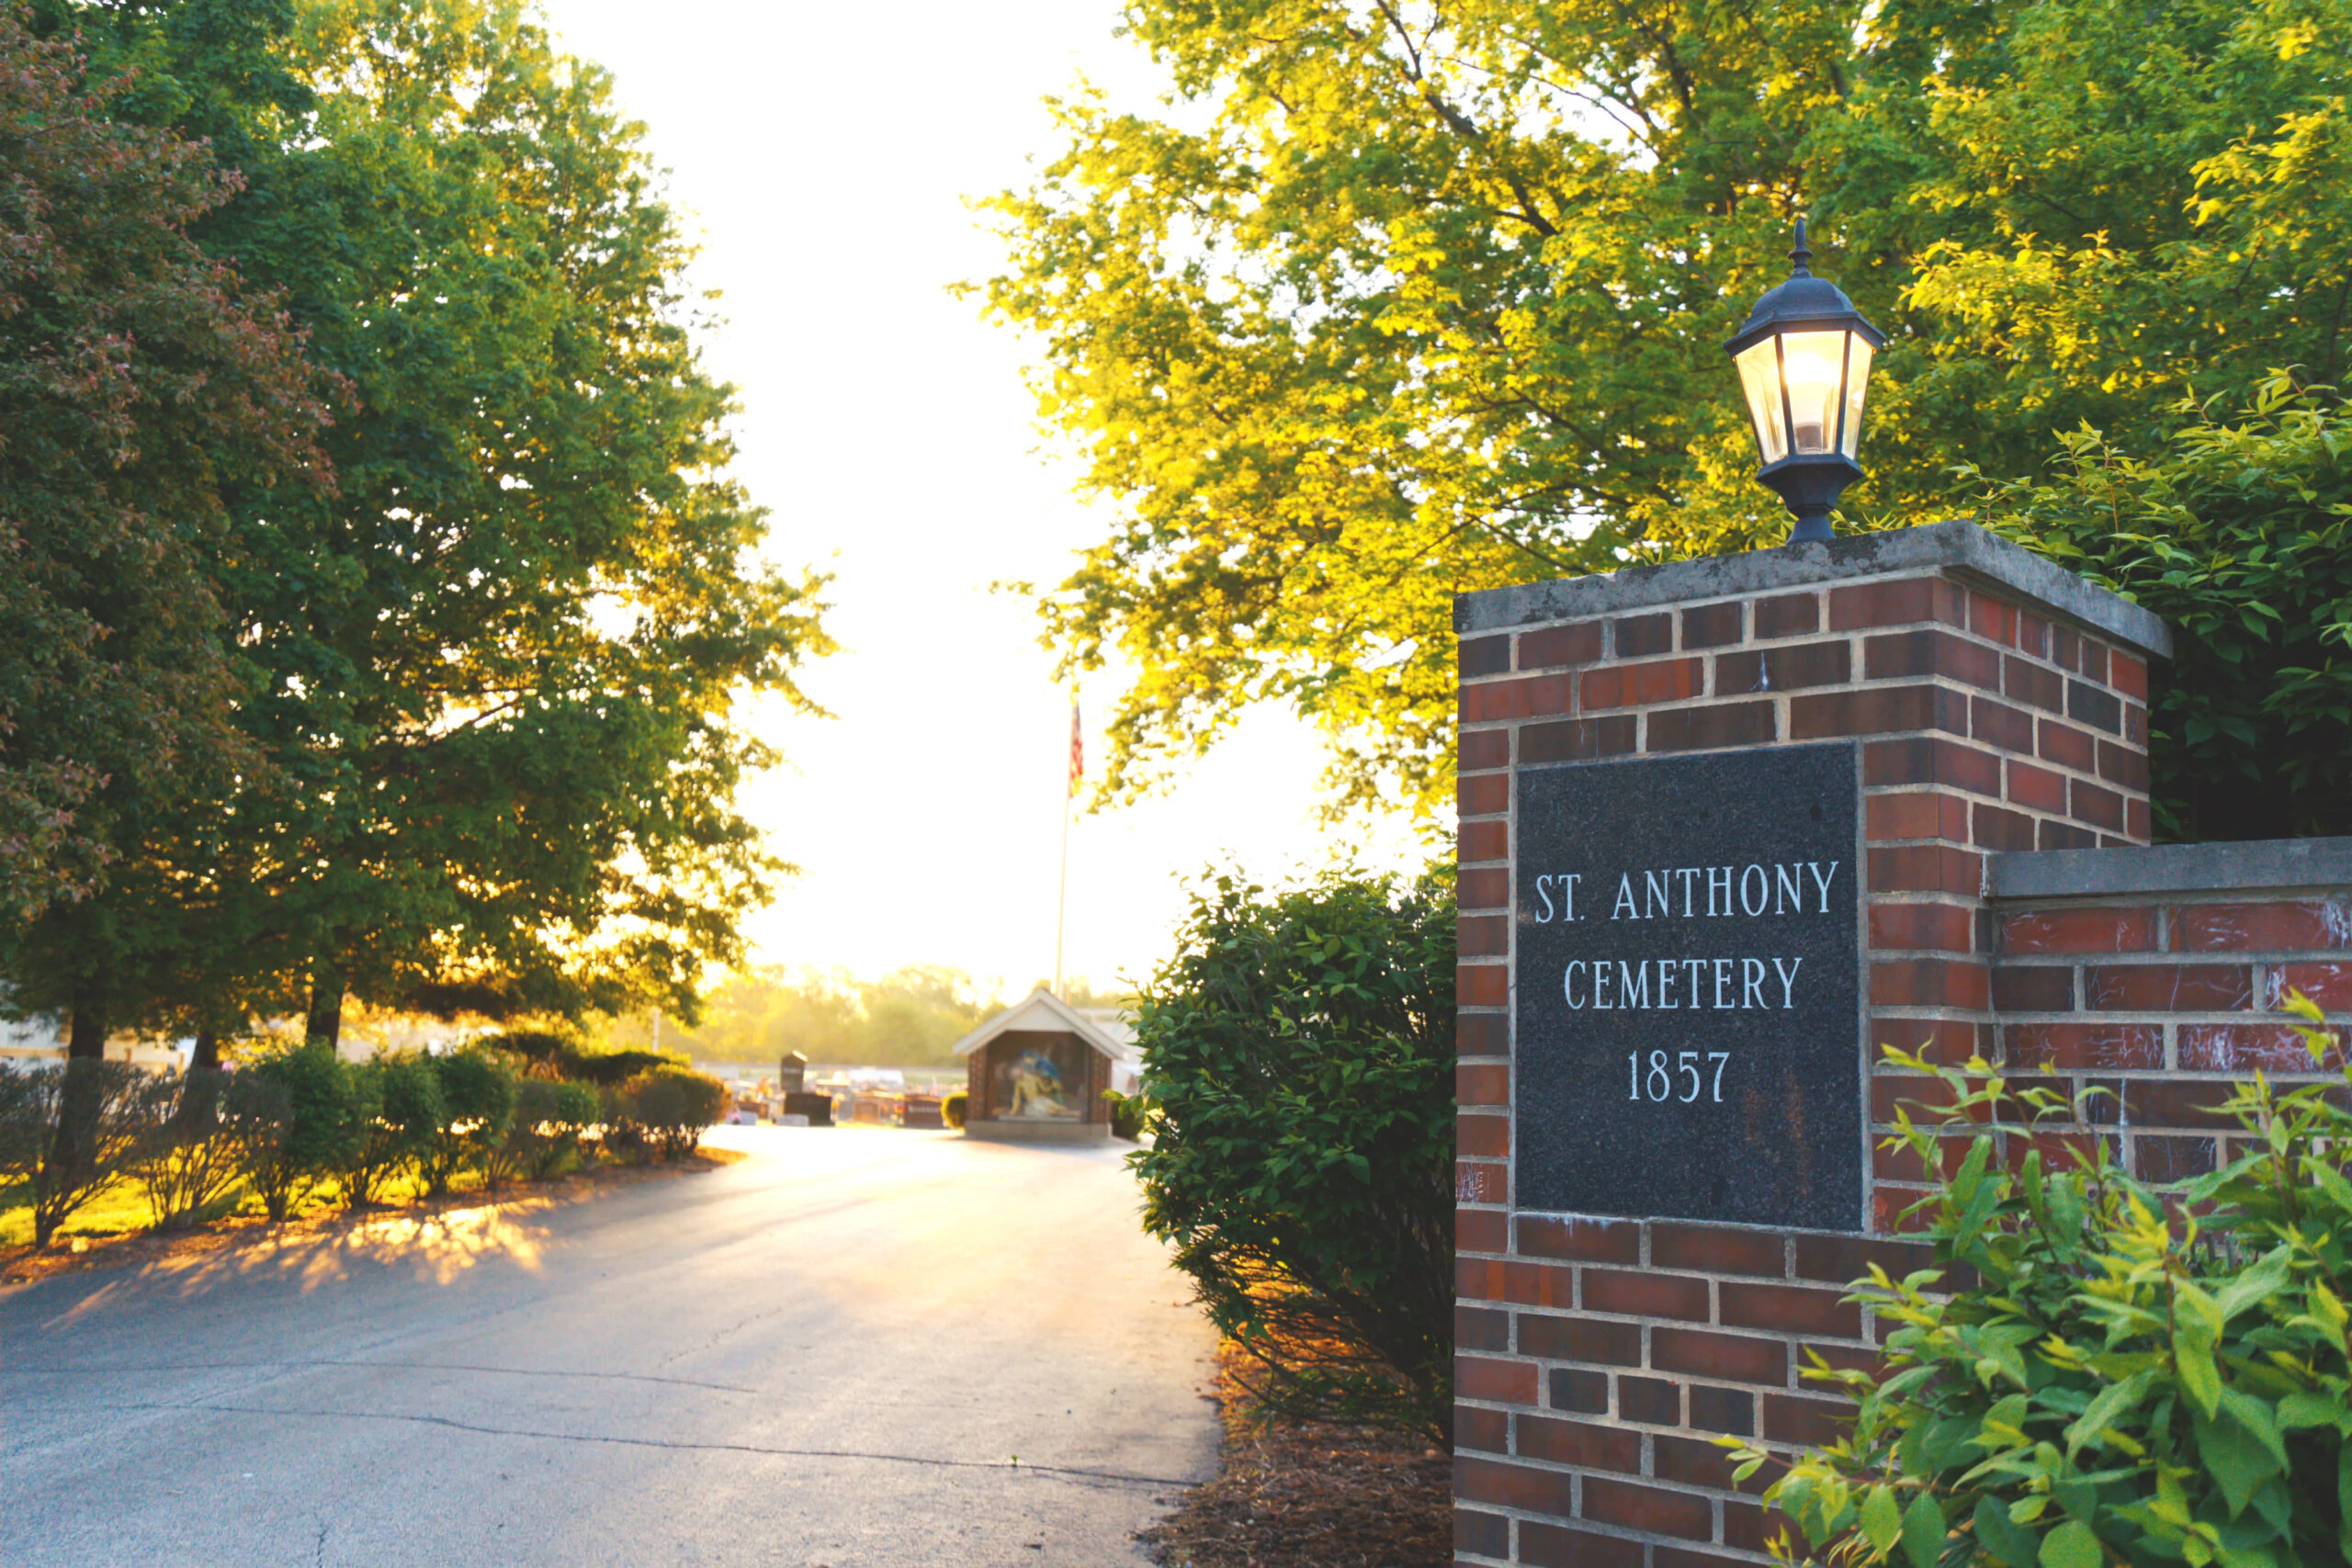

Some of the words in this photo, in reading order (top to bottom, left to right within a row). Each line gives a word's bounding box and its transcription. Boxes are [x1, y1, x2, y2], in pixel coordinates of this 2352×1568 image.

[1535, 874, 1585, 924] ST.
[1610, 861, 1839, 919] ANTHONY
[1564, 957, 1803, 1010] CEMETERY
[1628, 1049, 1730, 1103] 1857
